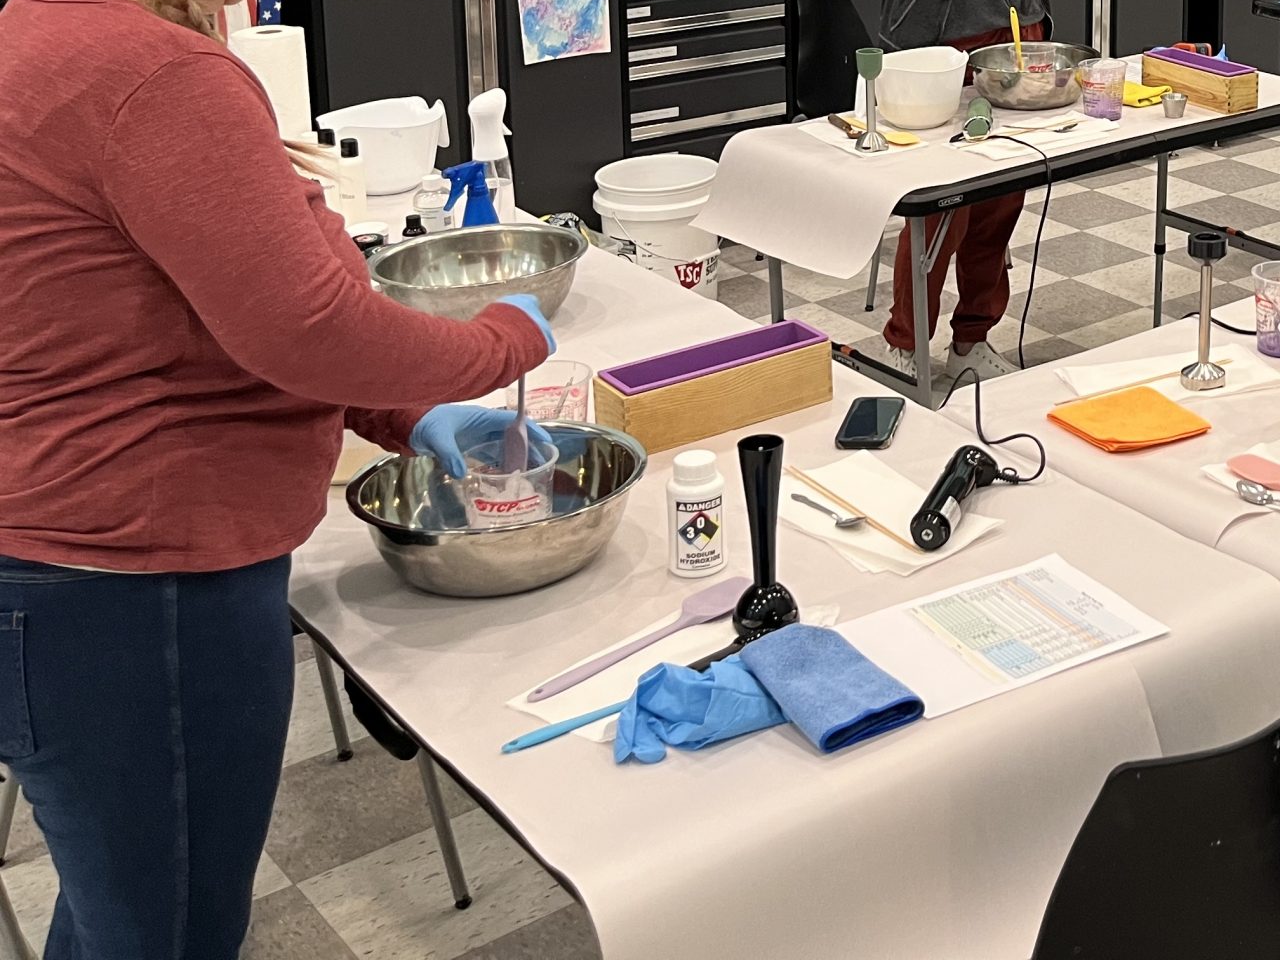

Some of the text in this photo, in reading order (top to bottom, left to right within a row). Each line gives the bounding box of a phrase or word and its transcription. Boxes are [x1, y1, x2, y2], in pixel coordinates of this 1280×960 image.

[677, 265, 700, 283] TSC
[686, 497, 721, 512] DANGER
[686, 526, 695, 539] 3
[680, 554, 721, 565] HYDROXIDE
[686, 550, 716, 559] SODIUM
